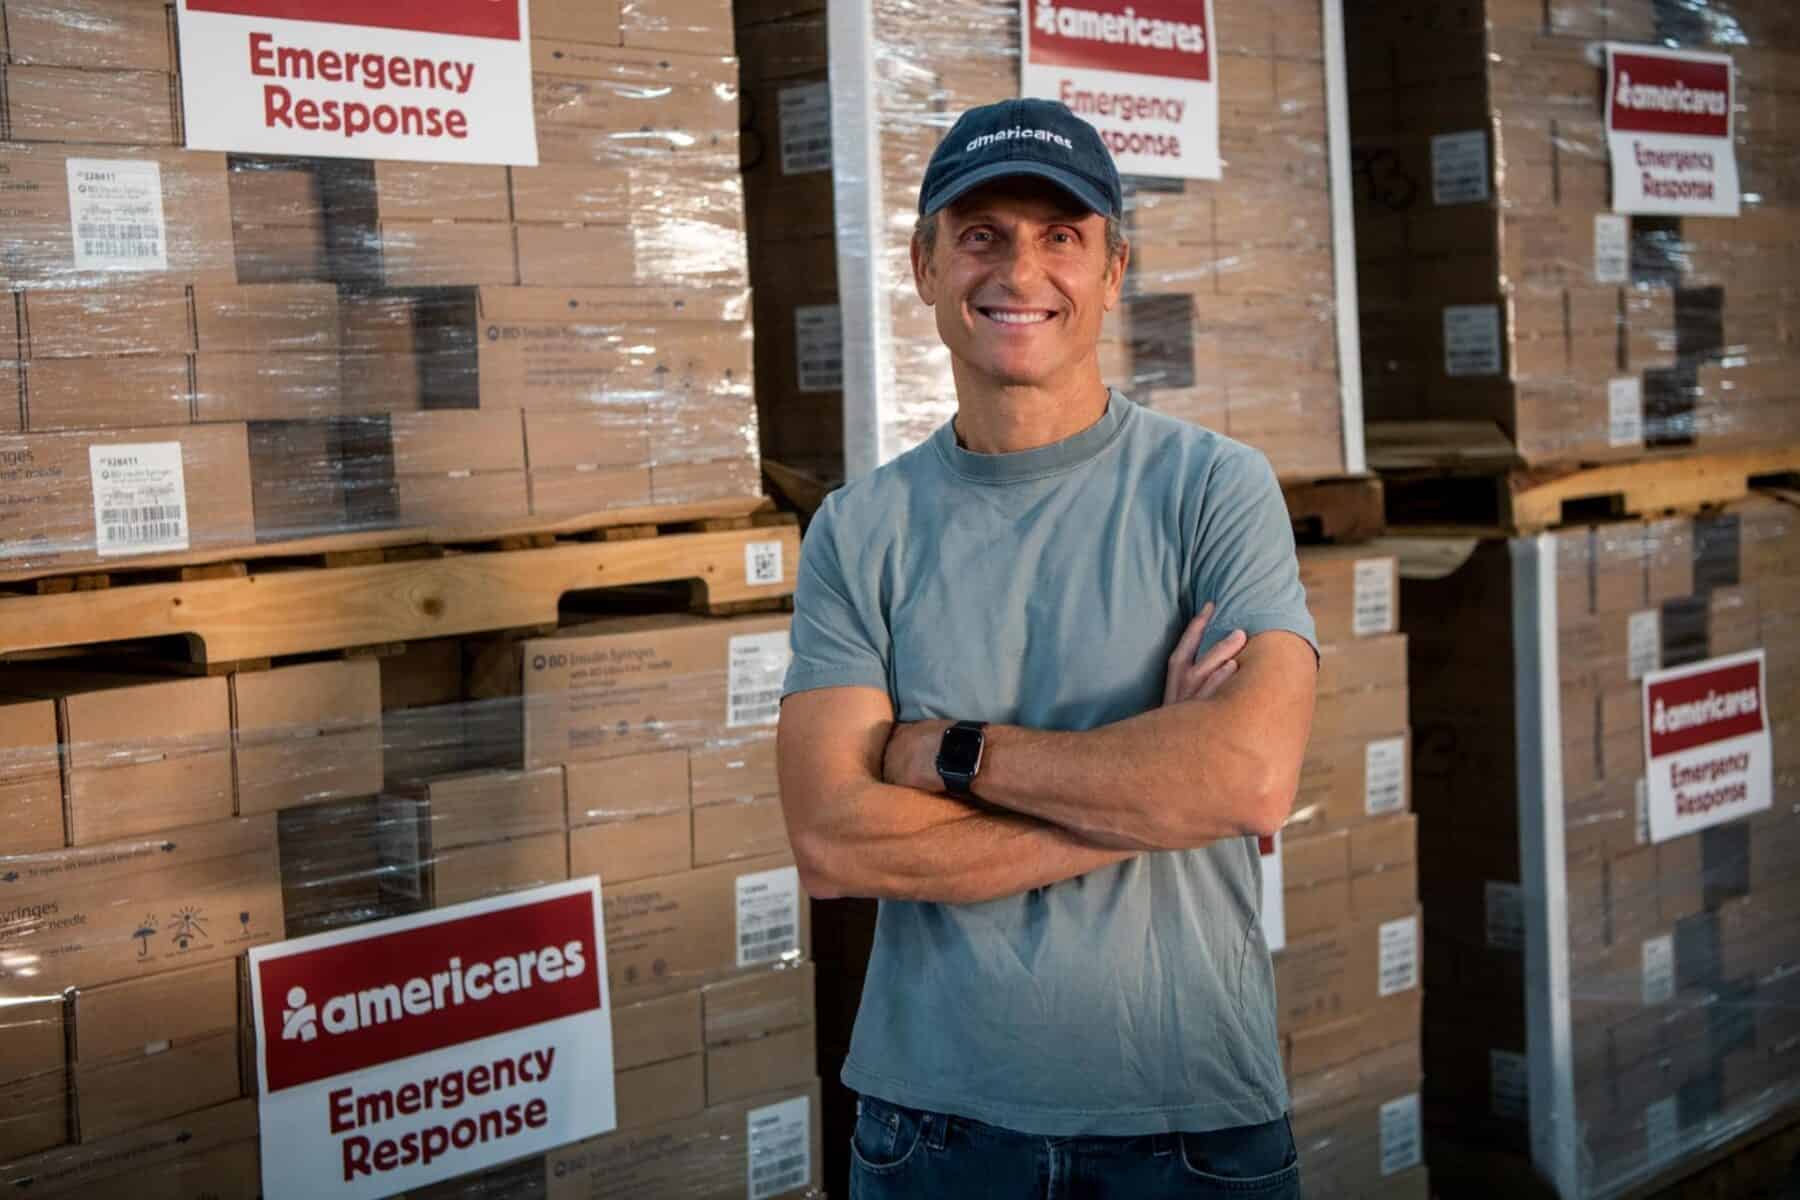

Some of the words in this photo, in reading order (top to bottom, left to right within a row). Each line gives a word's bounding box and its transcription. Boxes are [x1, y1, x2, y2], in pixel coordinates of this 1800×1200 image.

[1058, 7, 1205, 52] americares
[248, 31, 475, 94] Emergency
[262, 83, 469, 138] Response
[1058, 79, 1186, 124] Emergency
[1629, 80, 1727, 116] americares
[965, 125, 1074, 153] americares
[1101, 127, 1182, 158] sponse
[1633, 140, 1715, 174] Emergency
[1641, 171, 1714, 202] Response
[1664, 687, 1760, 734] americares
[1670, 751, 1749, 789] Emergency
[1675, 783, 1748, 818] Response
[0, 902, 59, 922] yringes
[321, 940, 587, 1035] americares
[328, 1046, 556, 1135] Emergency
[341, 1097, 549, 1182] Response
